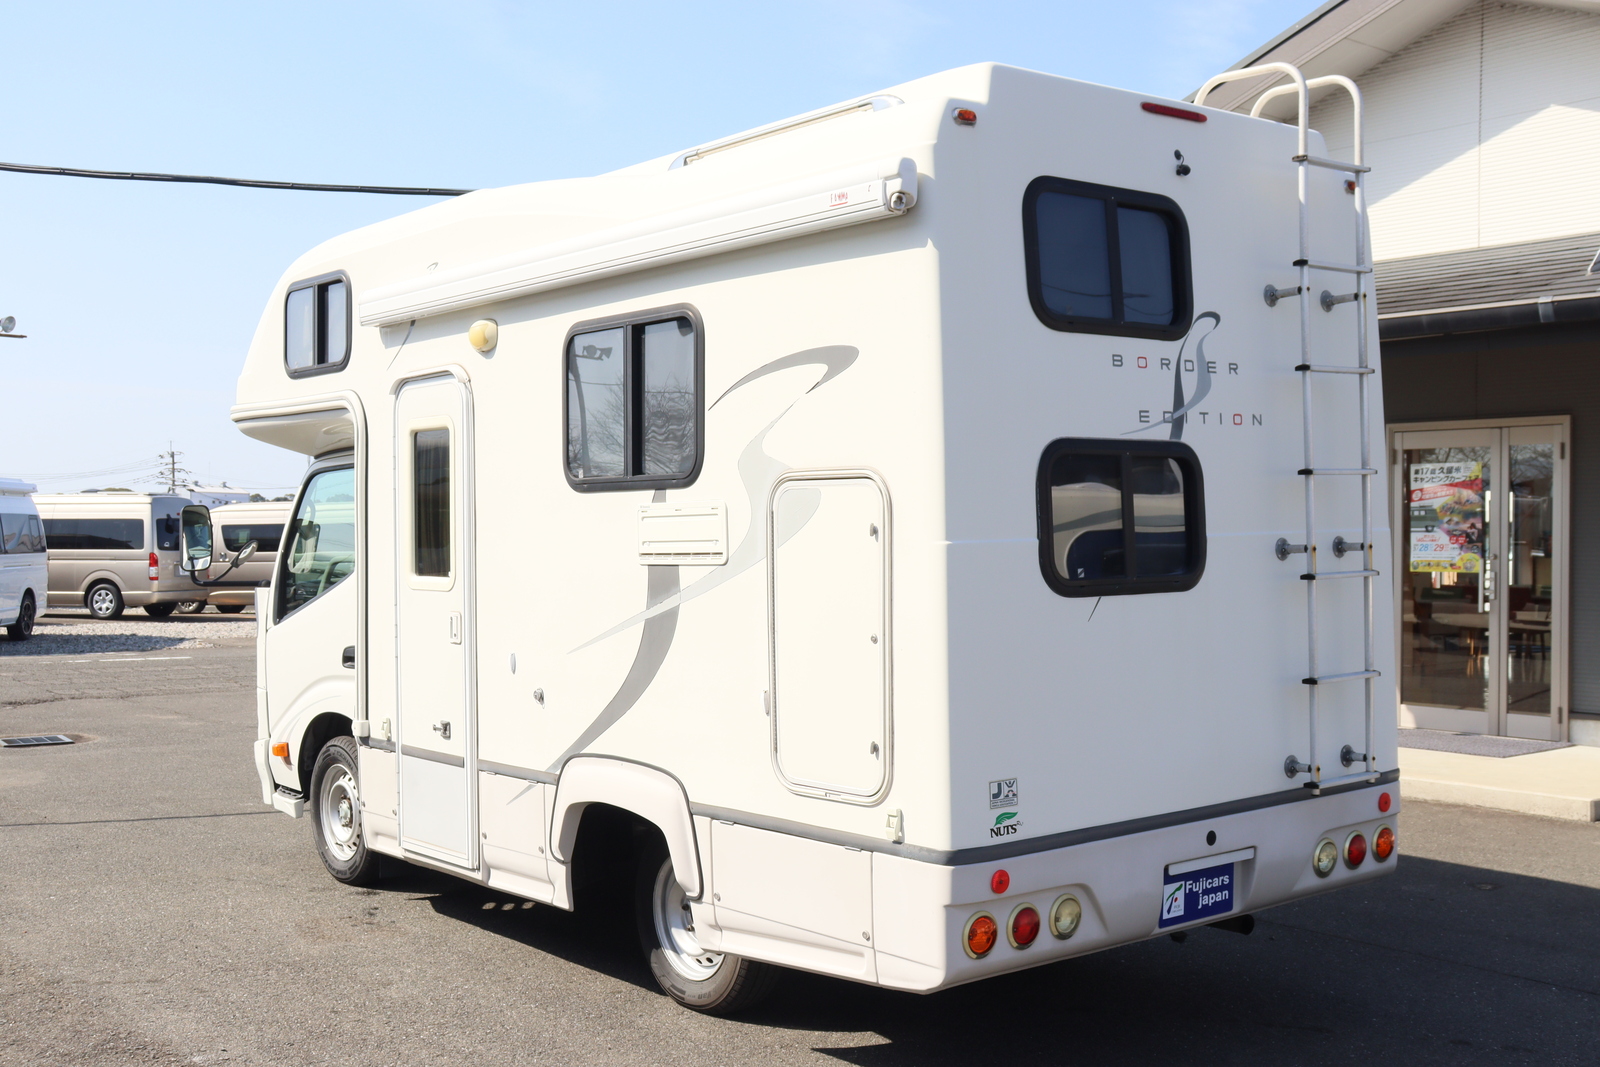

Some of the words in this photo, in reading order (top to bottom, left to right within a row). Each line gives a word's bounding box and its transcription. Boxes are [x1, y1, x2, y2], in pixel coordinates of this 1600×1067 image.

[1111, 353, 1239, 376] BORDER
[1138, 409, 1263, 426] EDITION
[1419, 543, 1429, 552] 28
[1433, 543, 1445, 552] 29
[989, 823, 1018, 838] NUTS
[1185, 874, 1230, 894] Fujicars
[1198, 890, 1229, 909] japan
